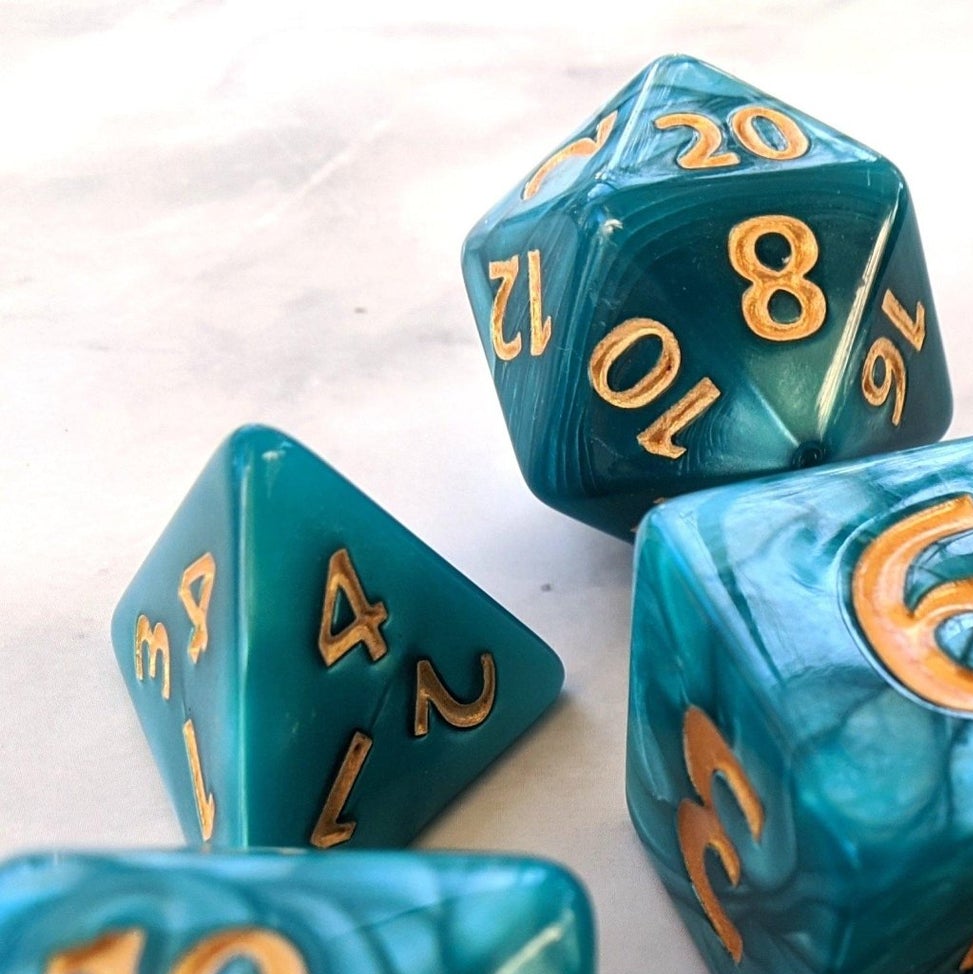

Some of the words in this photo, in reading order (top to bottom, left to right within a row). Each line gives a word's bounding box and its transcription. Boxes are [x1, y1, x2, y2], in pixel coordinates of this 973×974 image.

[655, 106, 810, 169] 20
[488, 249, 552, 361] 12
[727, 214, 827, 342] 8
[588, 317, 721, 460] 10
[862, 289, 926, 426] 16
[134, 614, 171, 700] 3
[178, 552, 216, 664] 4
[317, 548, 388, 669] 4
[412, 652, 496, 738] 2
[182, 719, 215, 842] 1
[310, 731, 373, 849] 1
[676, 703, 765, 965] 3
